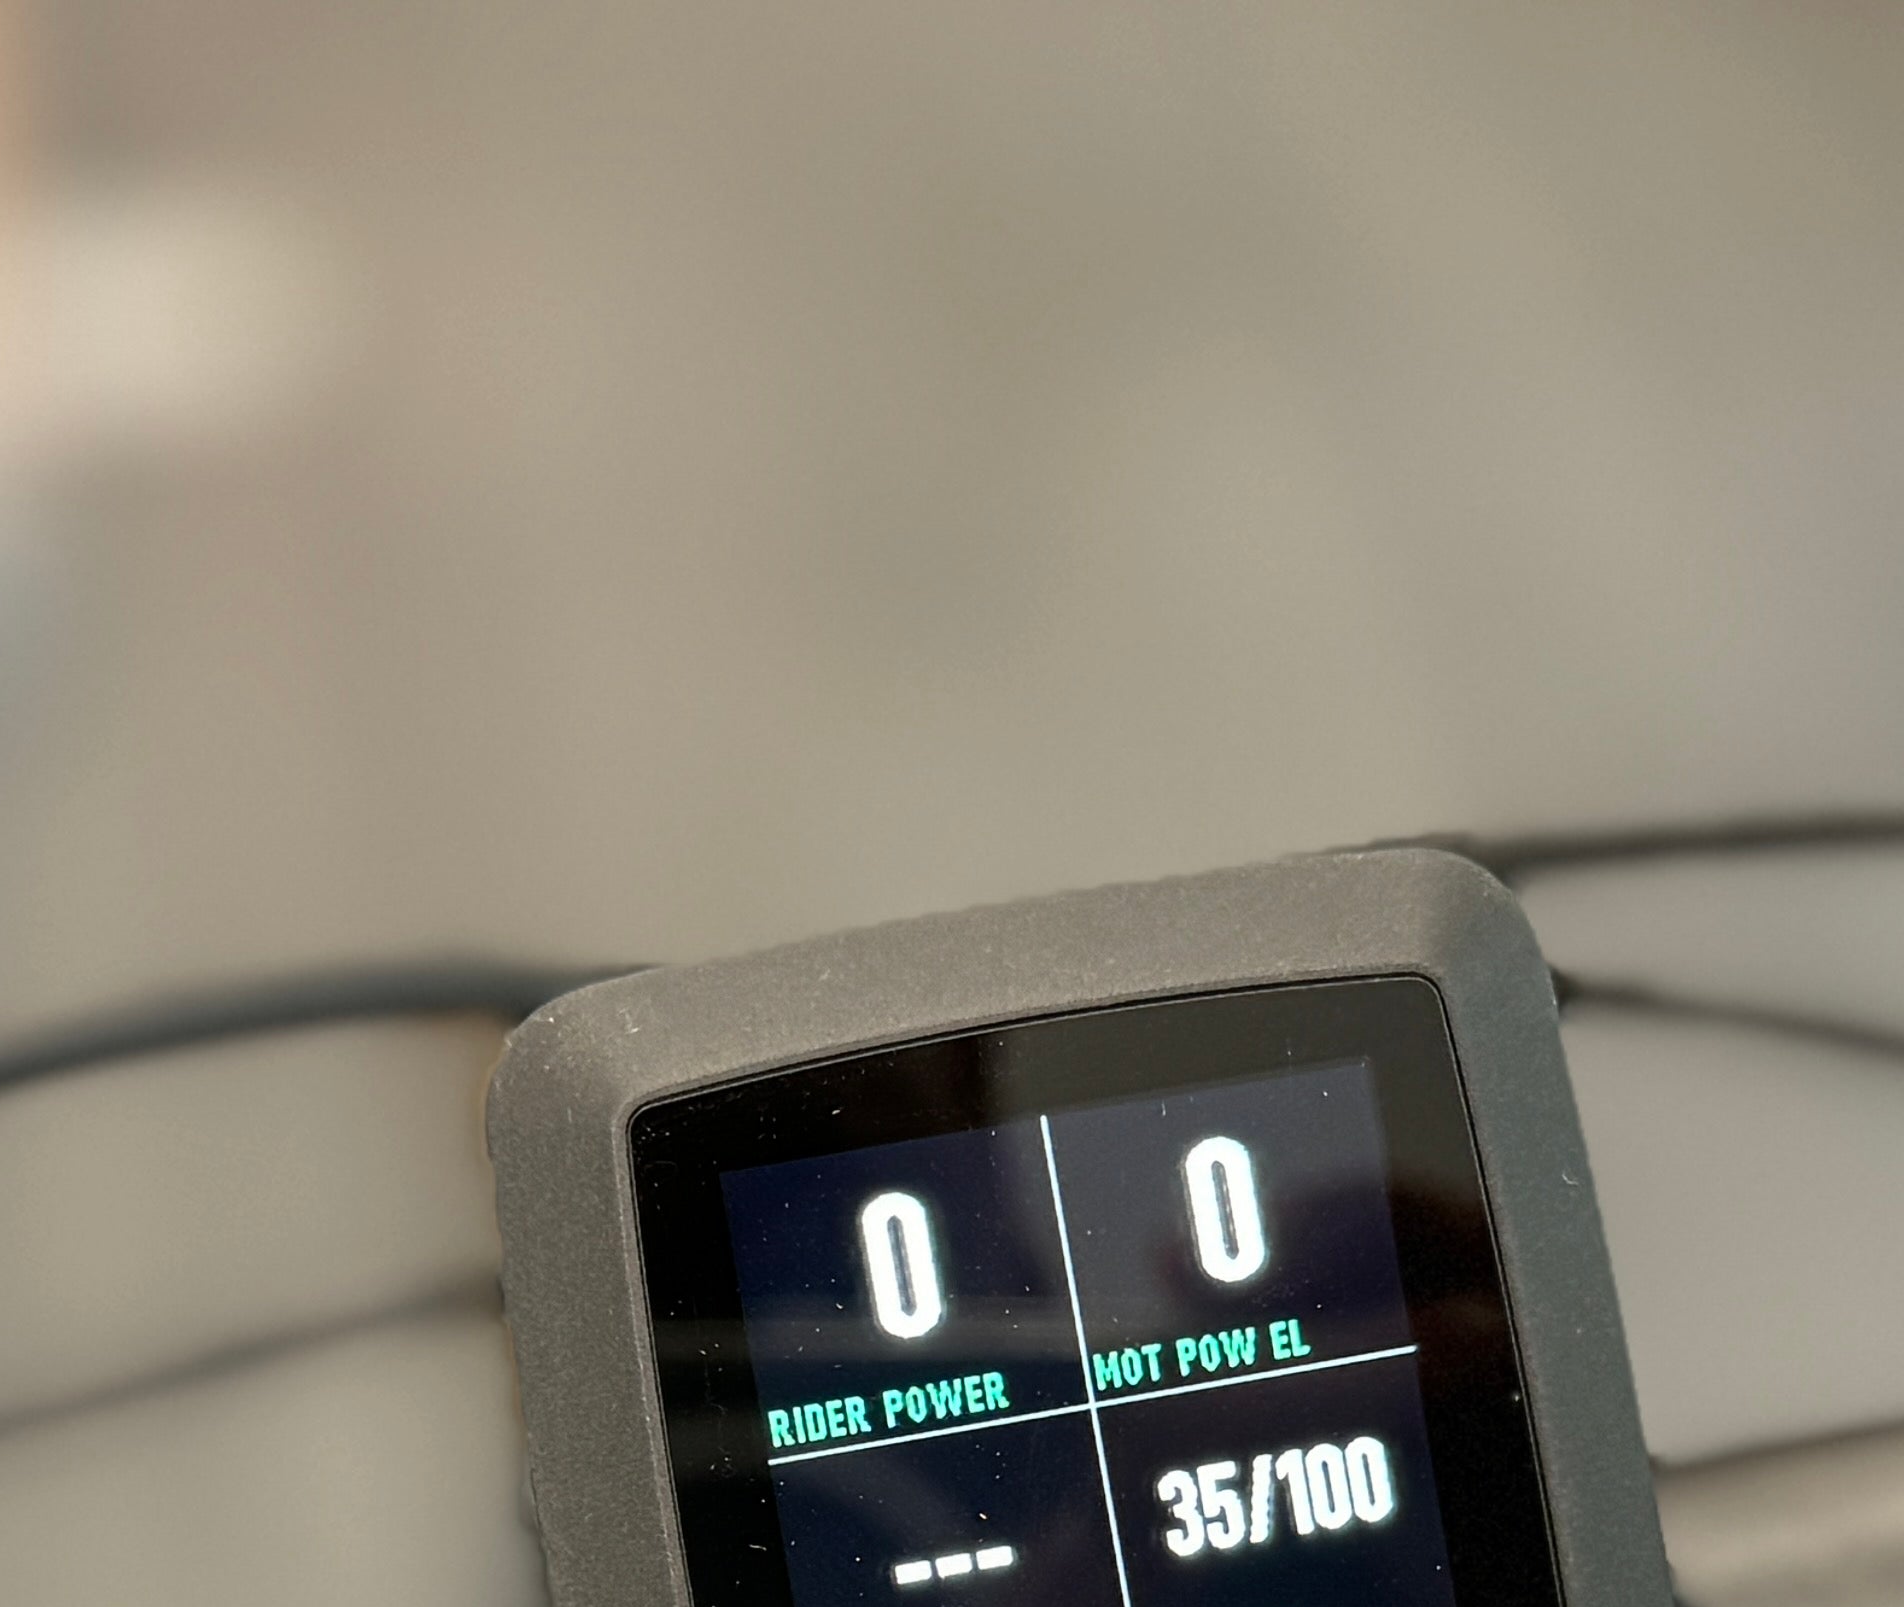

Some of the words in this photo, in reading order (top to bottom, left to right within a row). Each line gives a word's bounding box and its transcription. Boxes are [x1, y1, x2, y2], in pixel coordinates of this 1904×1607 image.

[860, 1192, 943, 1340] 0
[1181, 1136, 1267, 1283] 0
[768, 1398, 871, 1449] RIDER
[883, 1373, 1009, 1427] POWER
[1093, 1344, 1161, 1391] MOT
[1176, 1329, 1259, 1378] POW
[1270, 1320, 1311, 1360] EL
[1157, 1436, 1394, 1557] 35/100
